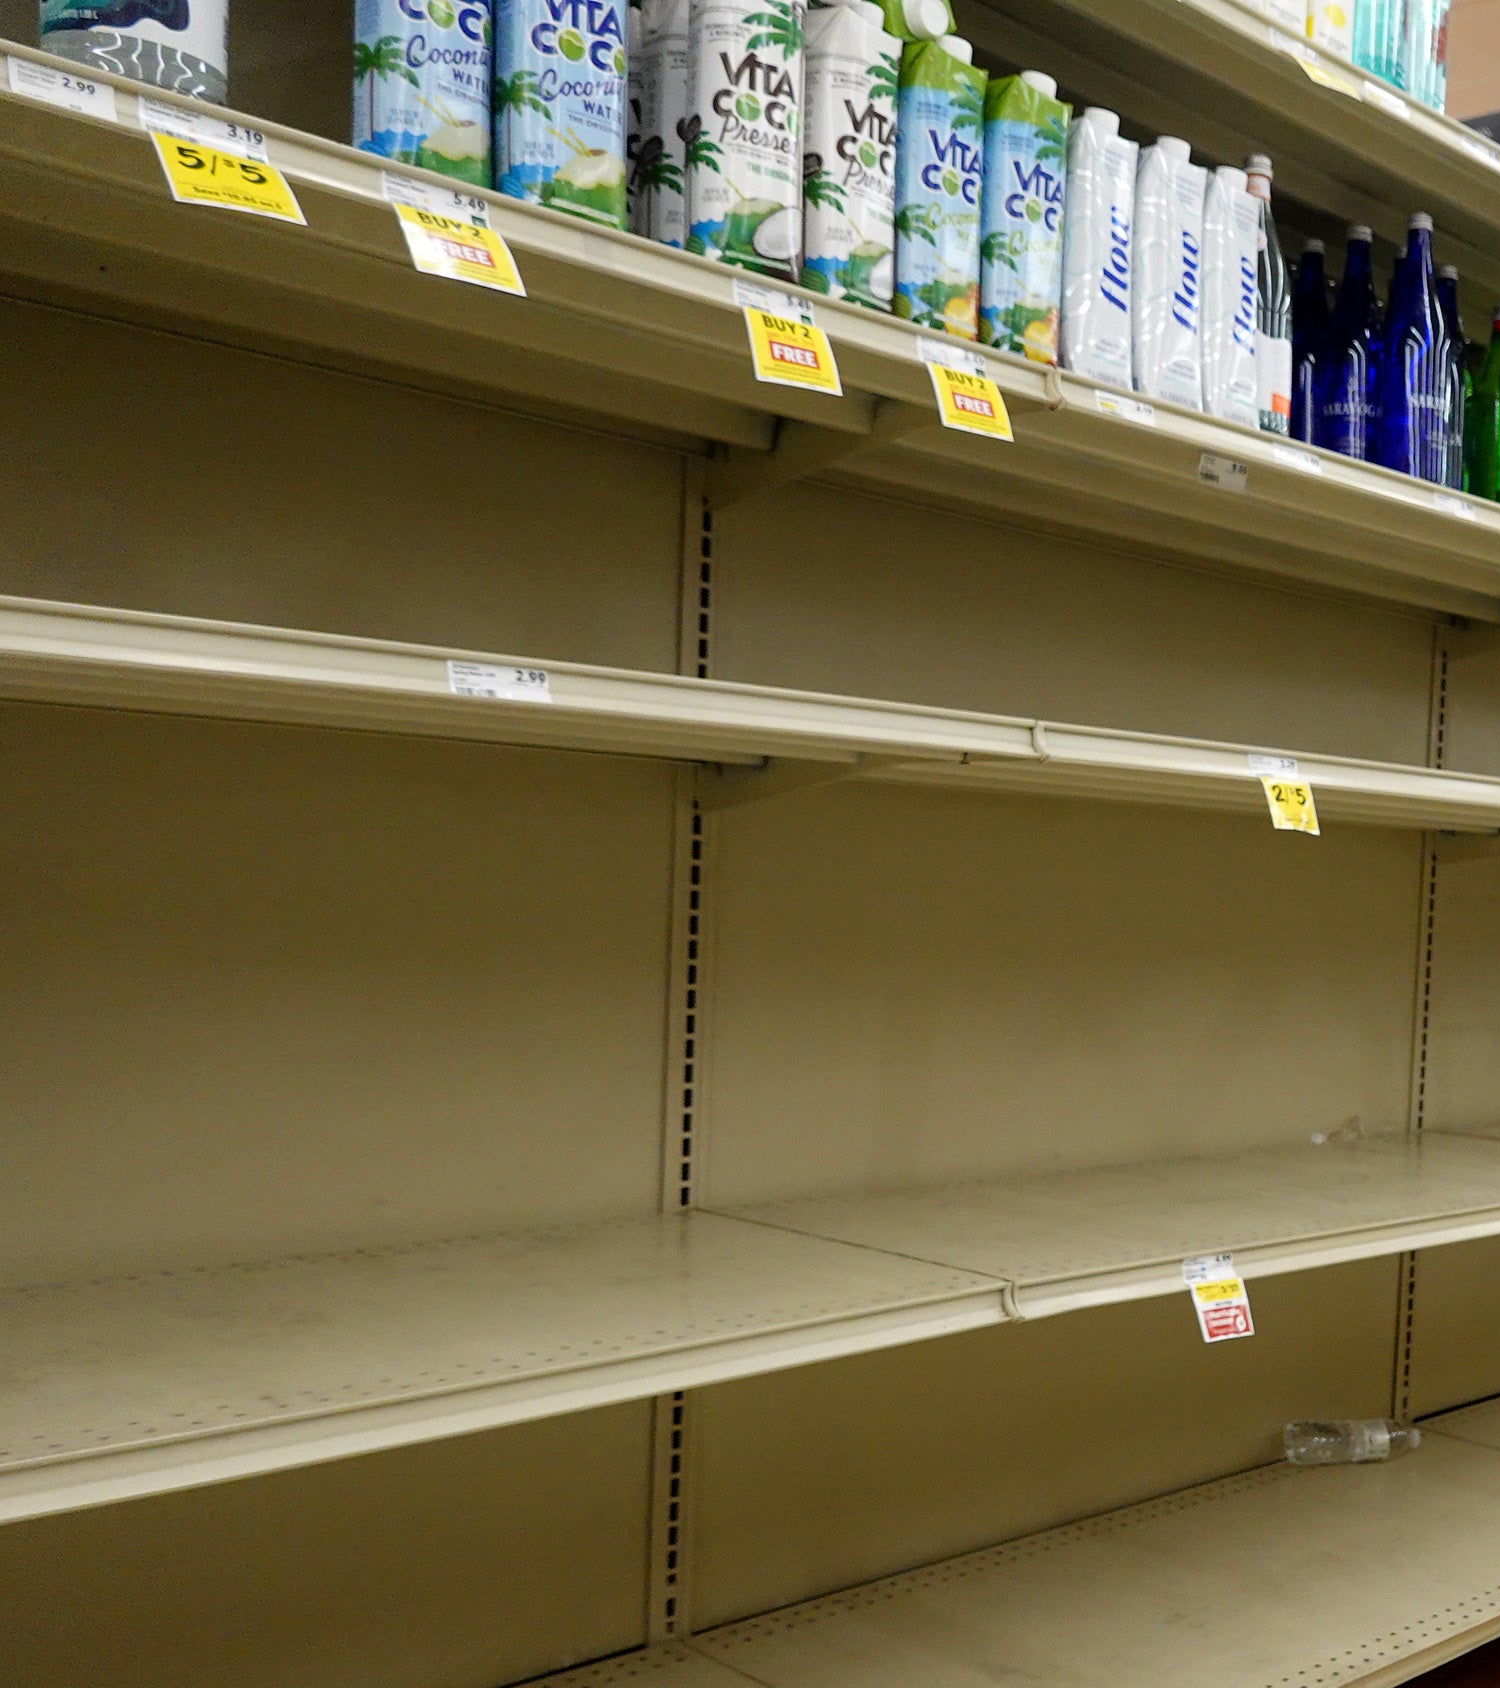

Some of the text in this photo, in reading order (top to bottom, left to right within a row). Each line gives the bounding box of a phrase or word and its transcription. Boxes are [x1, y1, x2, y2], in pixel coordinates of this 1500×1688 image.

[544, 0, 623, 46] VITA
[62, 77, 95, 94] 2.99
[719, 52, 796, 103] VITA
[227, 124, 263, 145] 3.19
[844, 99, 896, 146] VITA
[836, 134, 894, 176] COC
[929, 129, 983, 176] VITA
[921, 163, 980, 205] COC
[1013, 160, 1064, 206] VITA
[416, 211, 461, 231] BUY
[762, 314, 813, 339] BUY 2
[770, 341, 818, 368] FREE
[944, 369, 973, 387] BUY
[978, 380, 987, 391] 2
[953, 392, 994, 417] FREE
